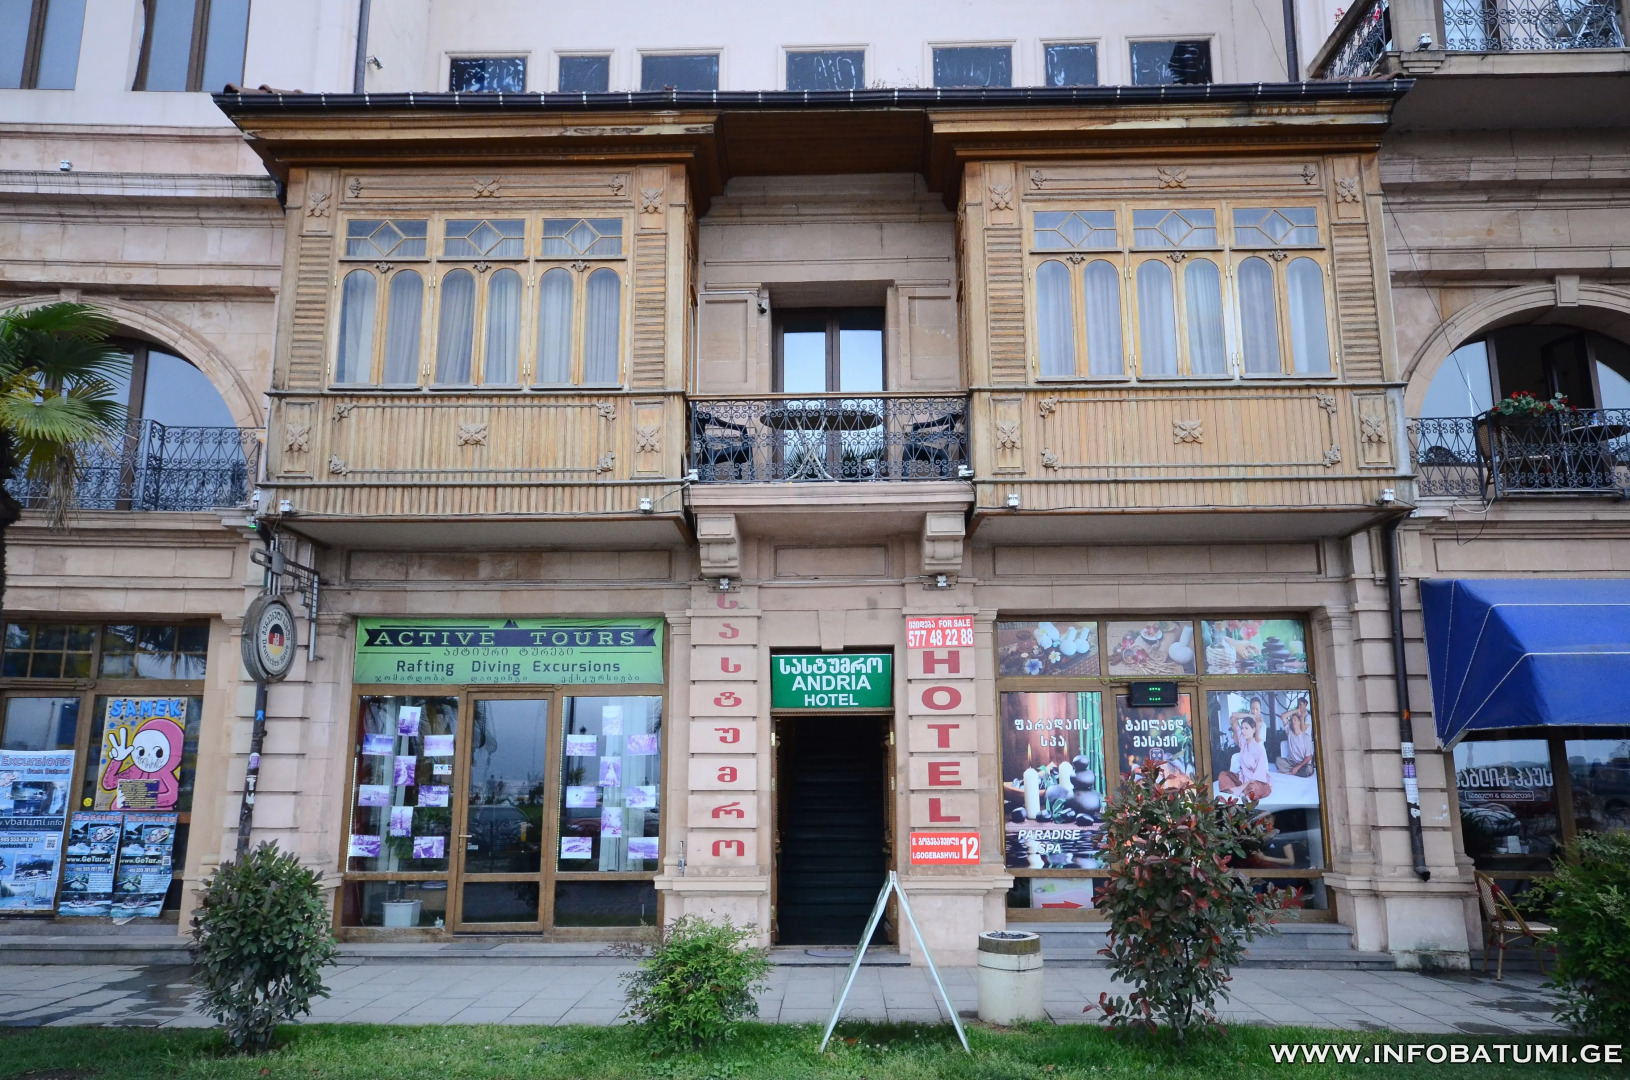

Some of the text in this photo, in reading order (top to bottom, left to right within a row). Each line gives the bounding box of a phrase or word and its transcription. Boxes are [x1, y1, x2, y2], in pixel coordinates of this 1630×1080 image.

[938, 619, 953, 628] FOR
[953, 618, 971, 627] SALE
[373, 631, 636, 646] ACTIVE TOURS
[908, 628, 974, 647] 577 48 22 88
[443, 647, 574, 657] აქტიური ტურები
[396, 659, 620, 676] Rafting Diving Excursions
[779, 657, 883, 675] სასტუმრო
[791, 674, 872, 691] ANDRIA
[804, 693, 859, 706] HOTEL
[110, 699, 182, 717] SAMEK
[1014, 718, 1090, 731] ფარადაის
[1125, 719, 1184, 731] ტაილანდ
[921, 650, 963, 823] HOTEL
[1040, 735, 1065, 747] სპა
[1133, 735, 1178, 747] მასაჟი
[1, 755, 71, 766] Excursions
[1018, 829, 1081, 840] PARADISE
[960, 837, 979, 859] 12
[1038, 843, 1061, 854] SPA
[912, 851, 960, 859] I.GOGEBASHVILI
